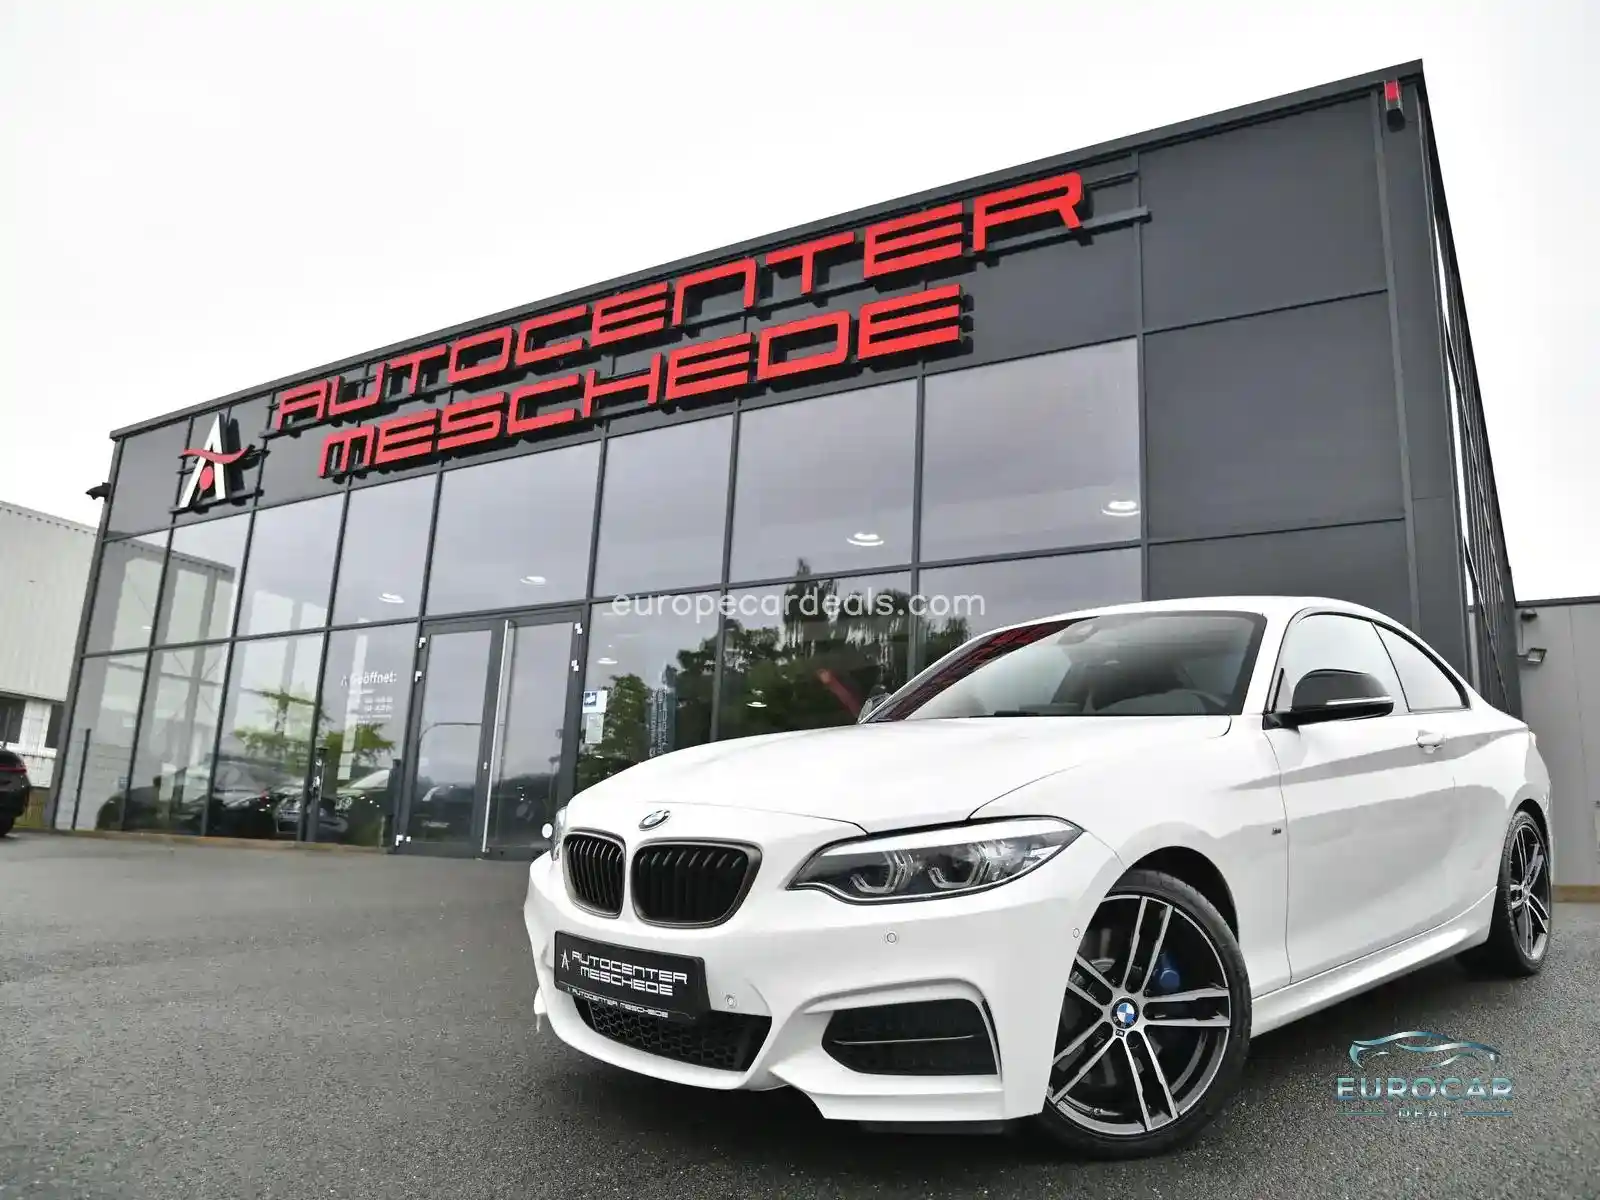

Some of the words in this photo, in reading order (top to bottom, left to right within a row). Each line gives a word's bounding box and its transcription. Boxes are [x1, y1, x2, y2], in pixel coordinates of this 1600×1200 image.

[274, 171, 1084, 431] AUTOCENTER
[318, 284, 962, 478] MESCHEDE
[571, 950, 688, 984] AUTOCENTER
[580, 966, 674, 997] MESCHEDE
